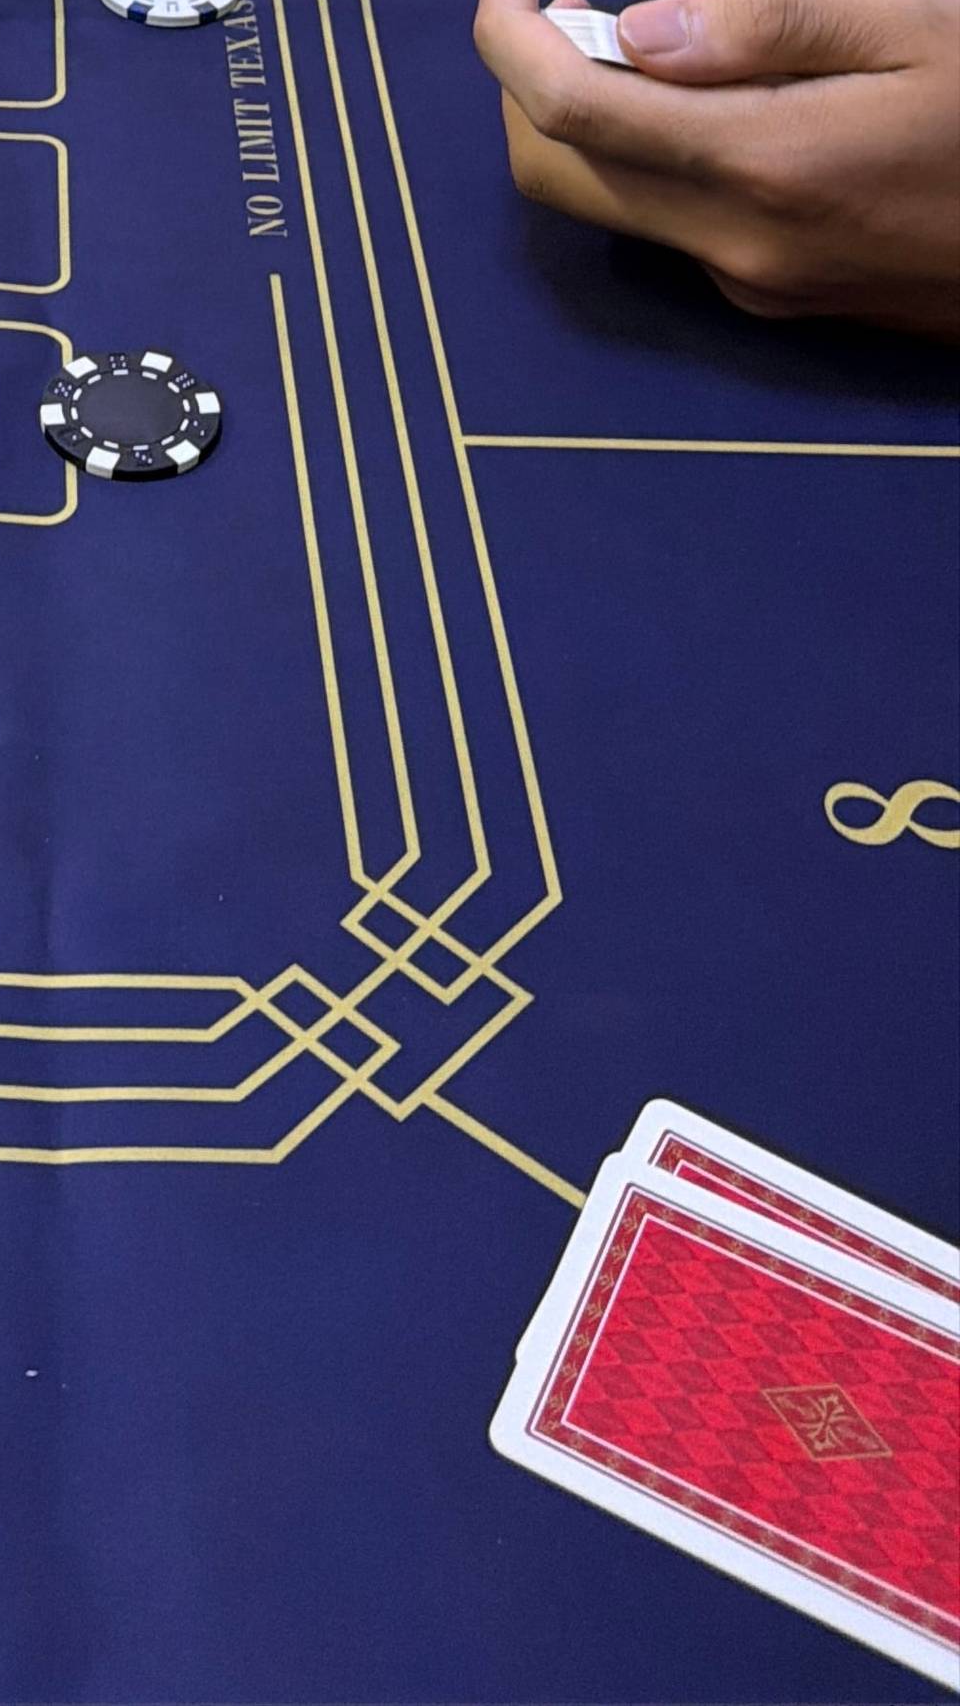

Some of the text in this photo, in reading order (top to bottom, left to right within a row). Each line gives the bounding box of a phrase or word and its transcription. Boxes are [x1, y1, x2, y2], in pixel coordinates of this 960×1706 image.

[233, 98, 281, 183] LIMIT
[246, 194, 289, 238] NO
[824, 780, 960, 849] 8
